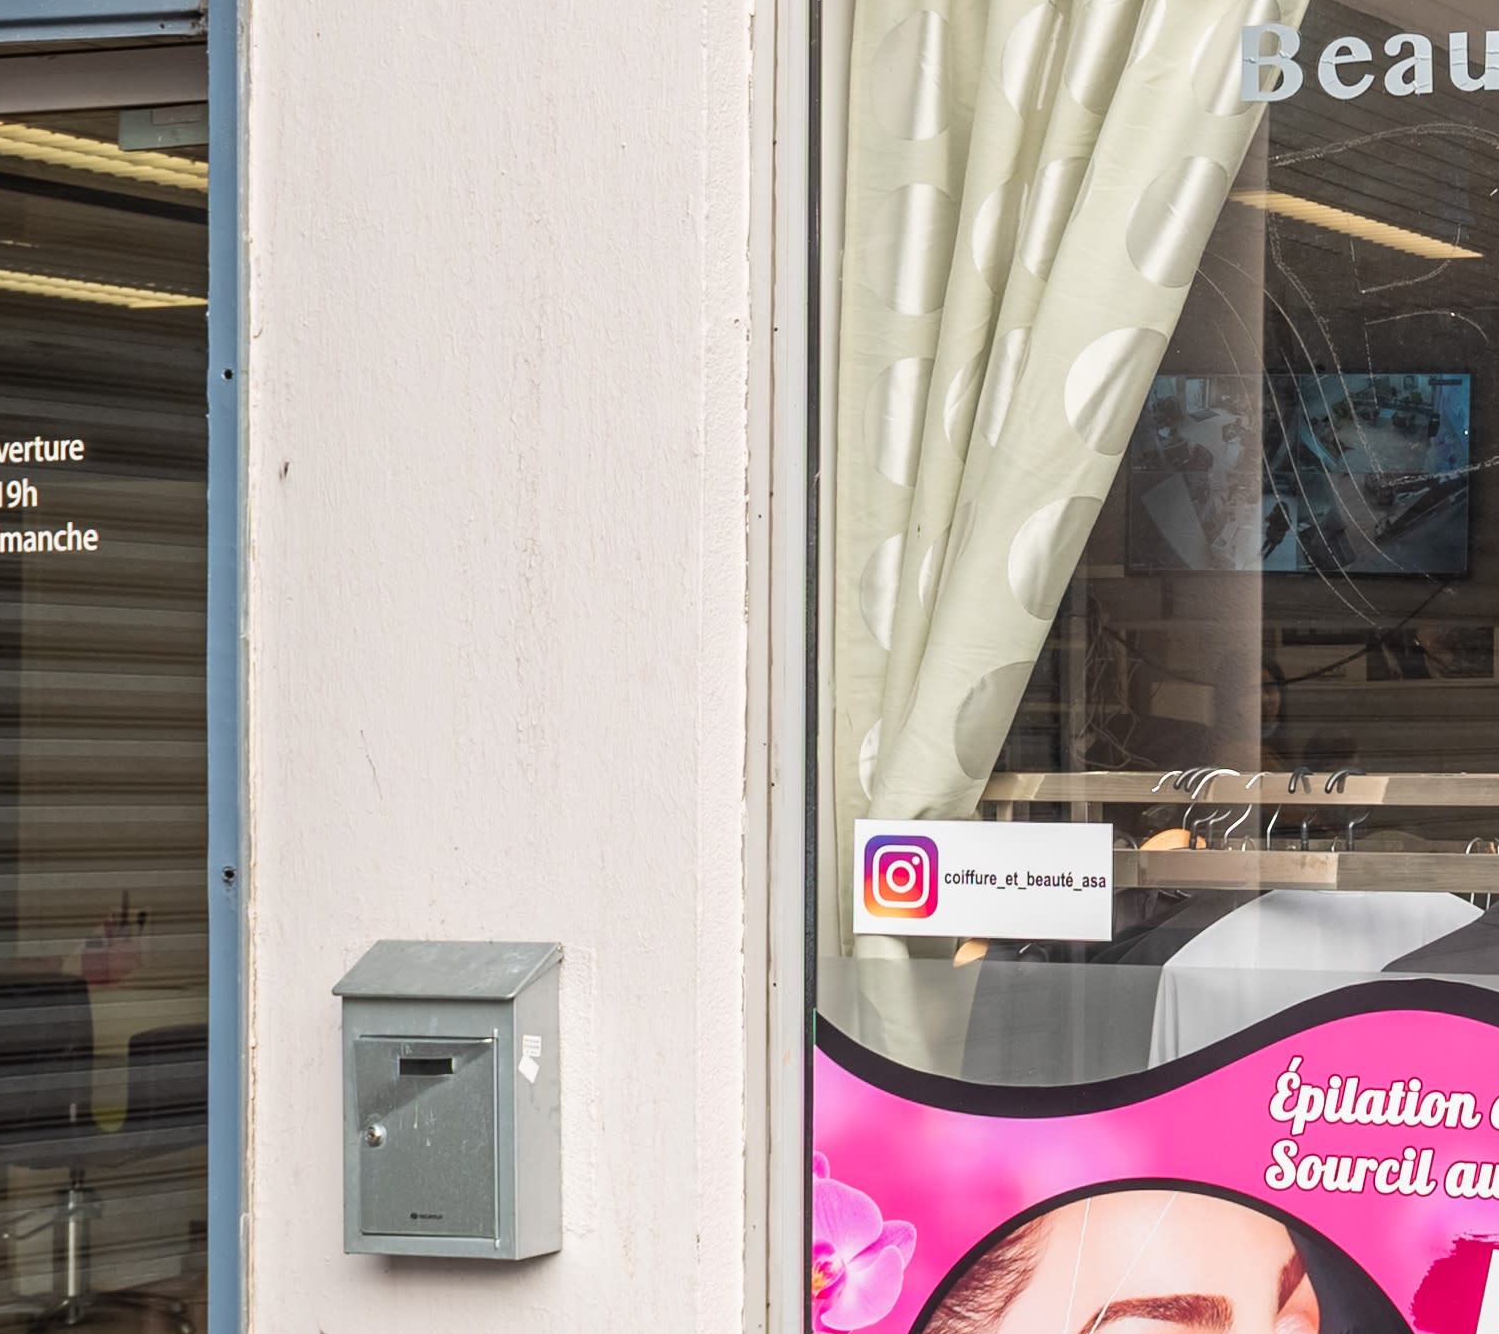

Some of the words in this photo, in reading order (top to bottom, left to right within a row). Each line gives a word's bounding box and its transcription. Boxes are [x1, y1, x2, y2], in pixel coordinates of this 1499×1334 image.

[944, 869, 1106, 891] coiffure_et_beauté_asa
[1268, 1056, 1481, 1138] Épilation
[1265, 1138, 1435, 1198] Sourcil
